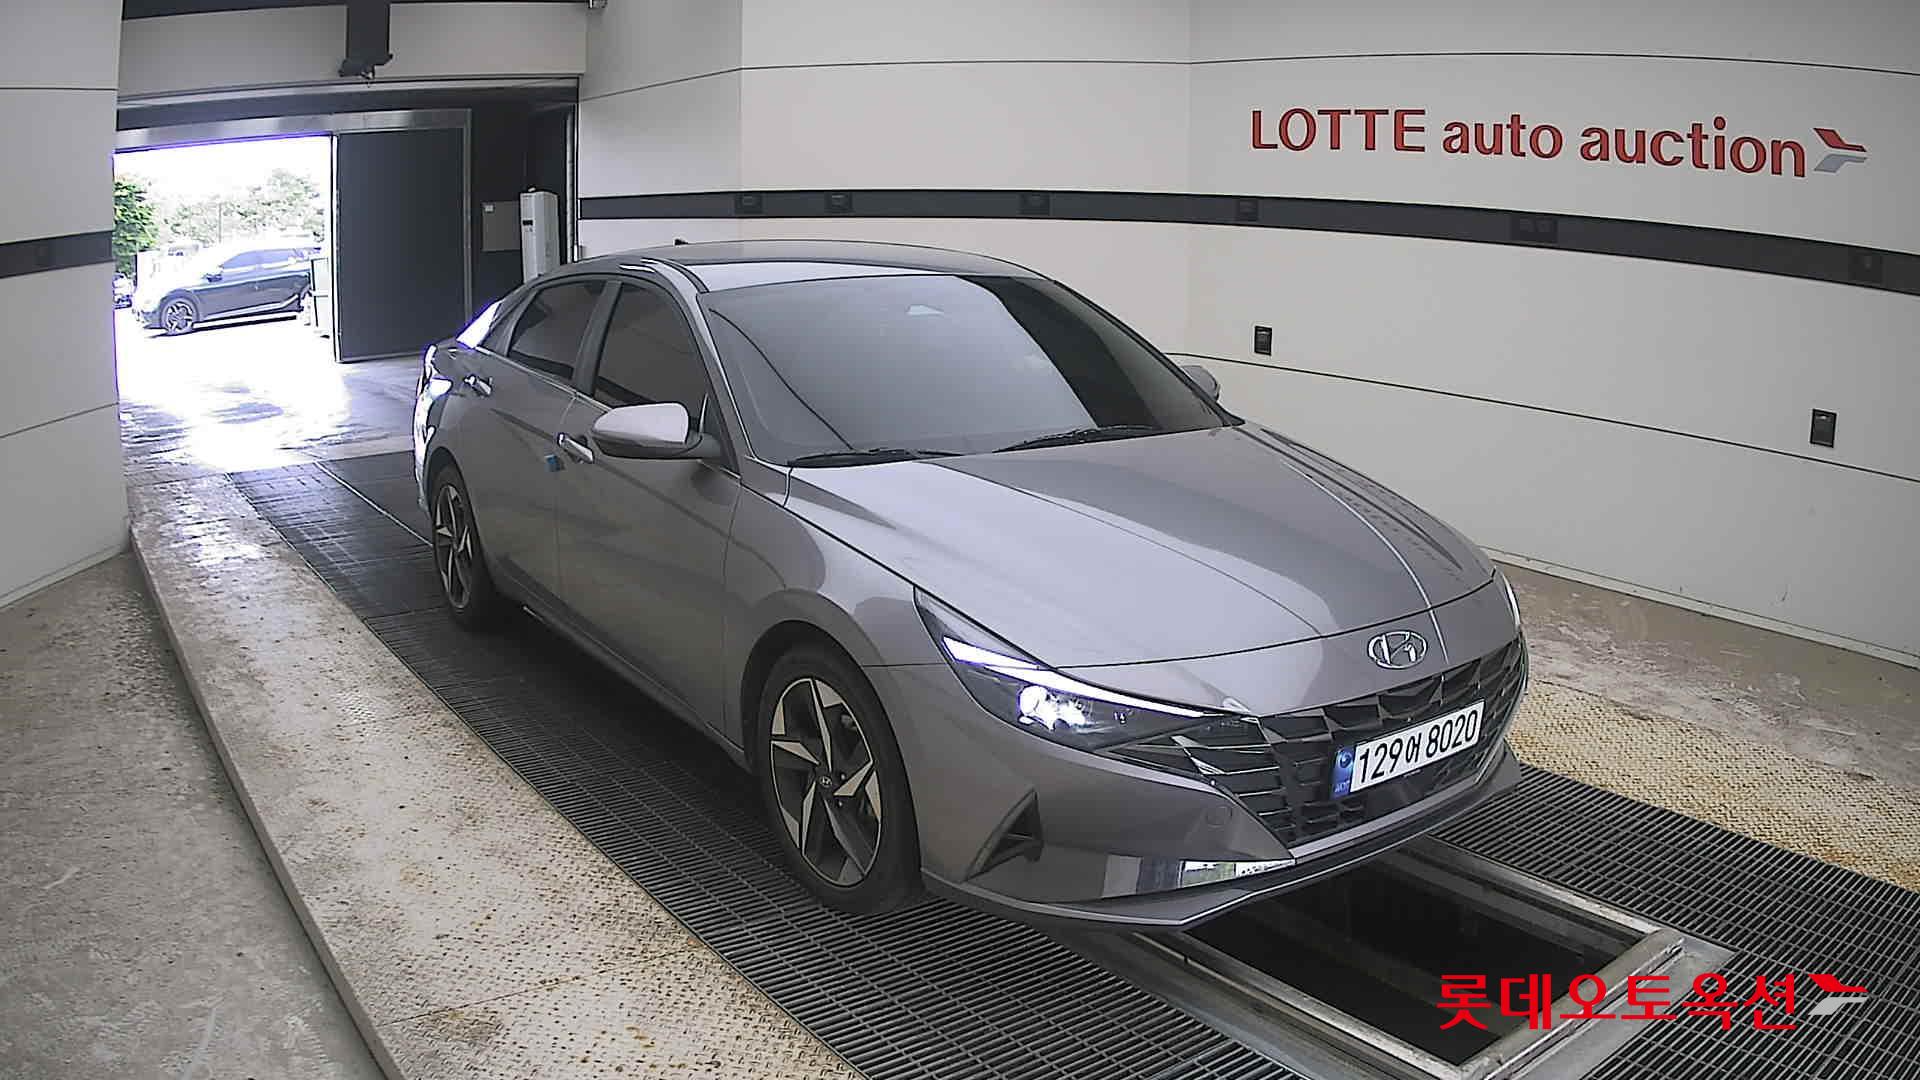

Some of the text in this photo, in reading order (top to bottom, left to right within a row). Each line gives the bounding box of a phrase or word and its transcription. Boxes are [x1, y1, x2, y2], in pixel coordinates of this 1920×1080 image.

[1251, 108, 1807, 178] LOTTE auto auction
[1359, 709, 1478, 783] 129어 8020
